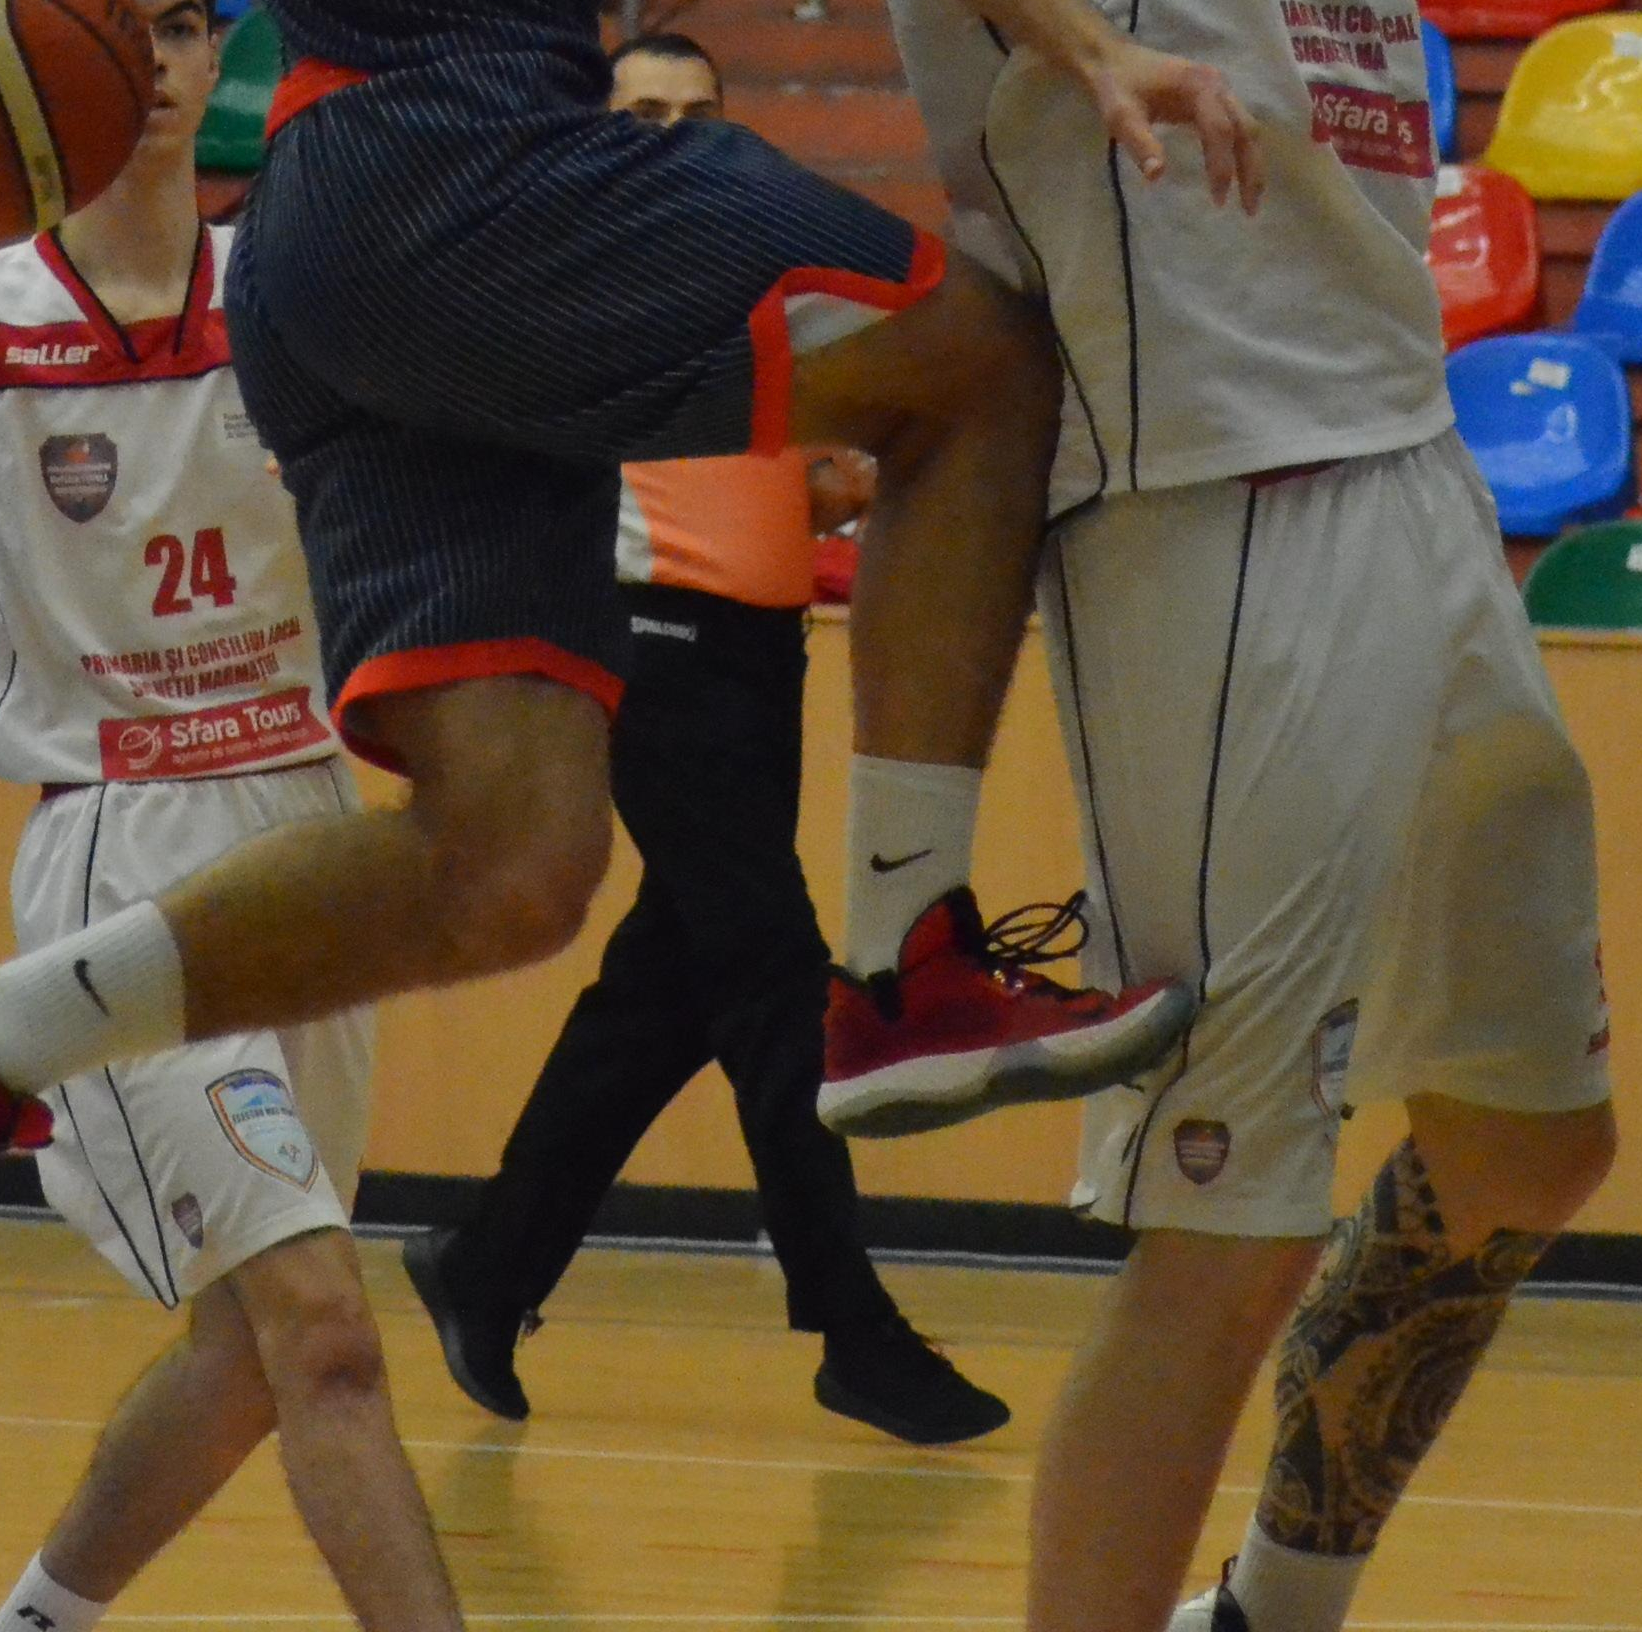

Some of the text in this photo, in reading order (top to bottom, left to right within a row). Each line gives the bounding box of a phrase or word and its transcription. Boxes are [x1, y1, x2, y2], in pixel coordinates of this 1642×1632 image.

[1322, 93, 1389, 135] Sfara
[143, 526, 238, 618] 24
[170, 717, 240, 749] Sfara
[242, 700, 302, 734] Tours
